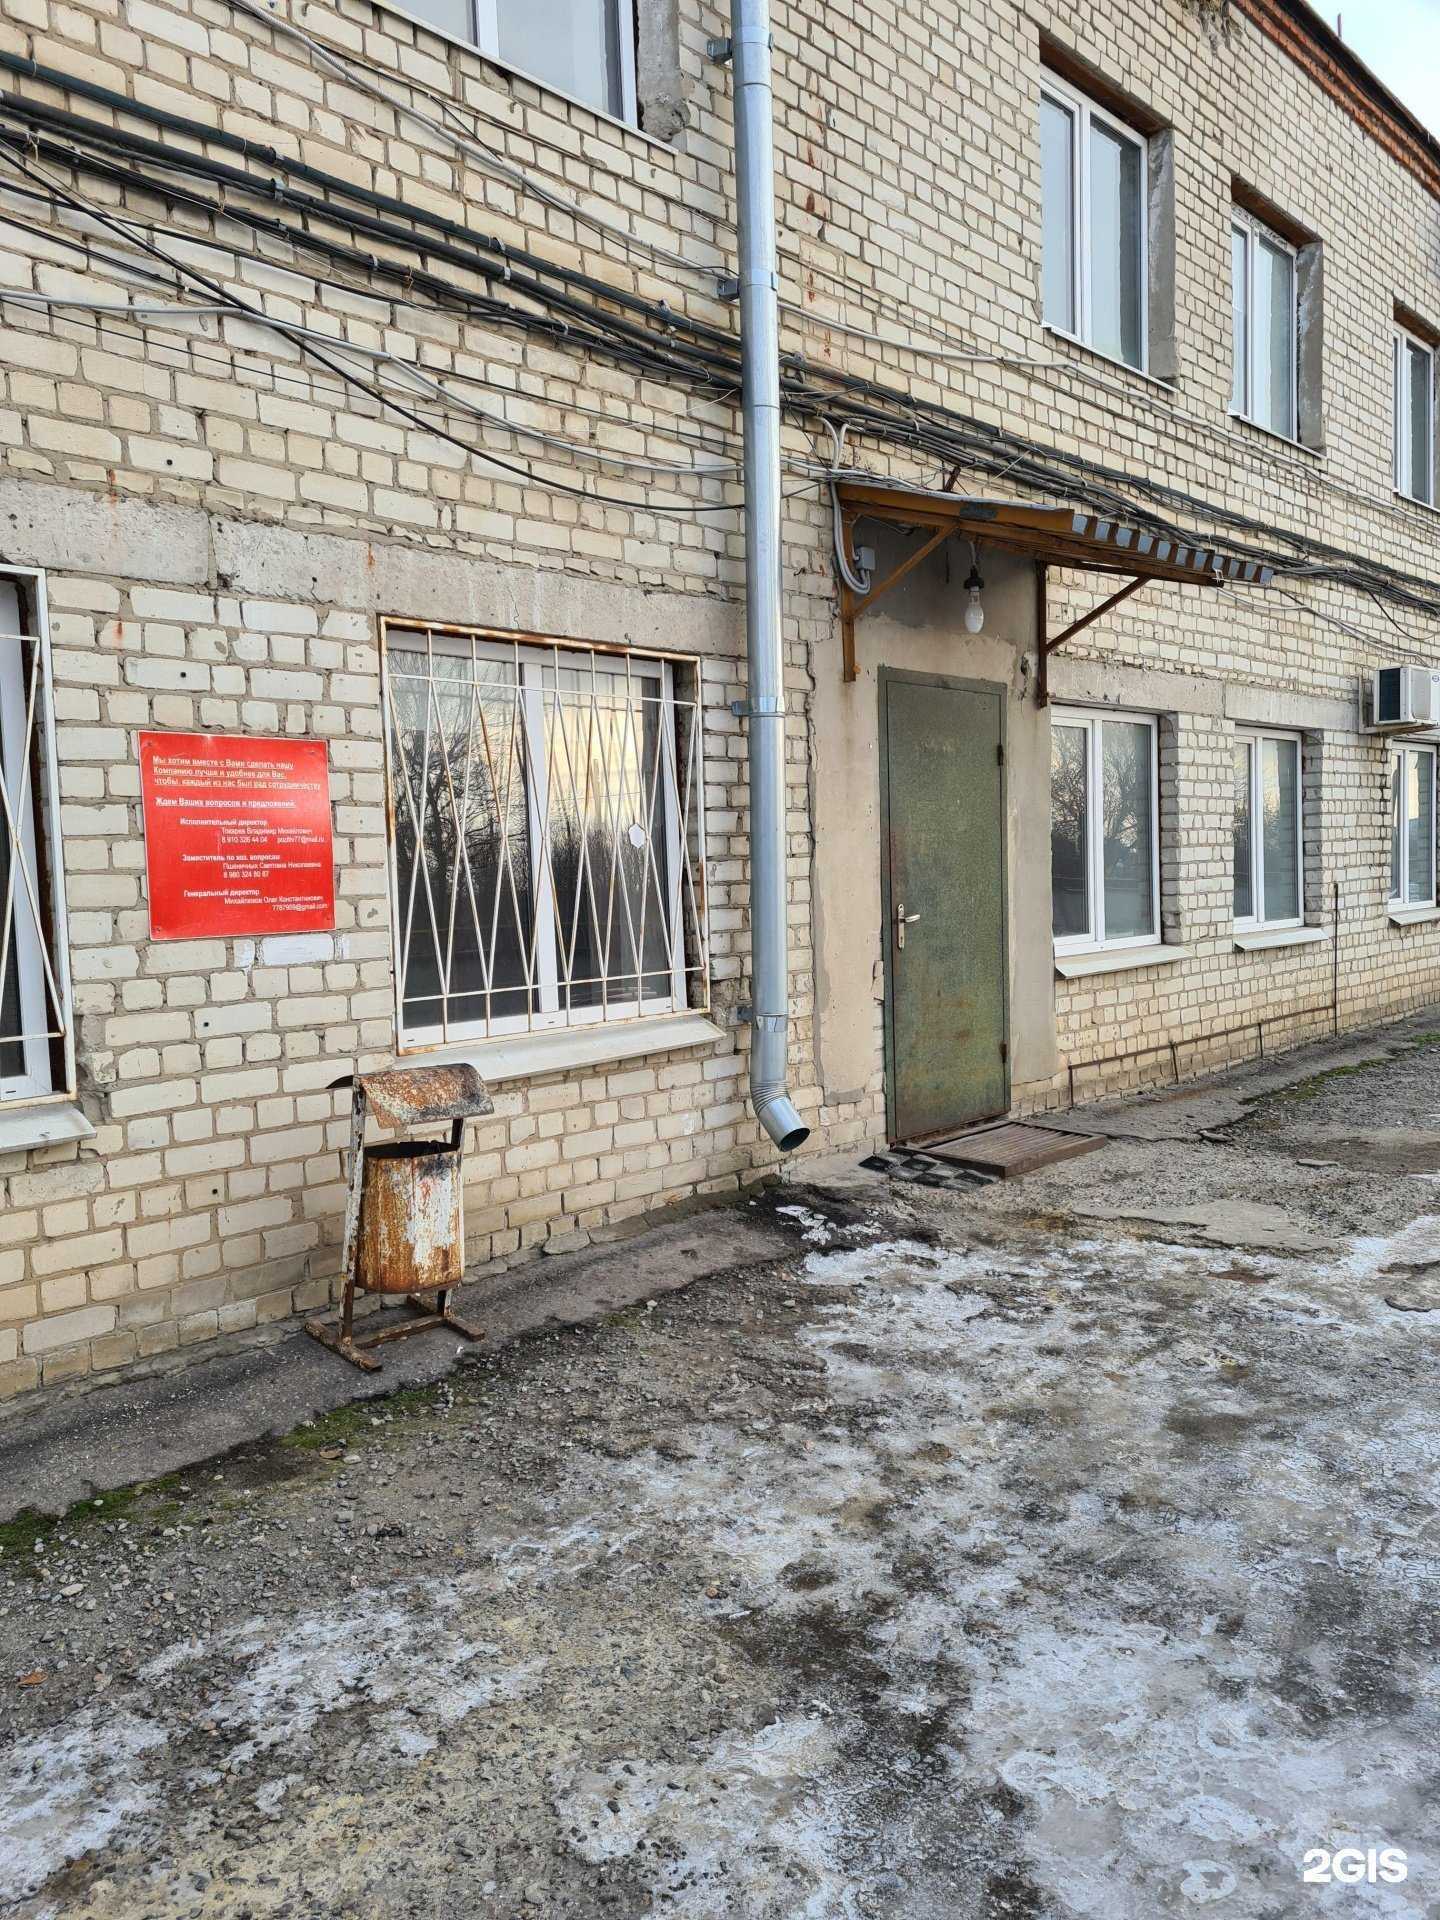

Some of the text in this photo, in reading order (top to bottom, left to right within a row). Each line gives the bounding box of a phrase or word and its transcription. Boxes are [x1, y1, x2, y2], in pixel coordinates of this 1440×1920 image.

[153, 755, 166, 765] Мы
[192, 759, 218, 767] вместе
[246, 761, 275, 769] сделать
[276, 762, 294, 771] нашу
[154, 766, 193, 775] Компанию
[223, 780, 235, 788] нас
[236, 779, 252, 788] был
[179, 798, 203, 808] Ваших
[205, 799, 240, 808] вопросов
[182, 854, 225, 862] Заместитель
[184, 889, 260, 899] Генеральный директор
